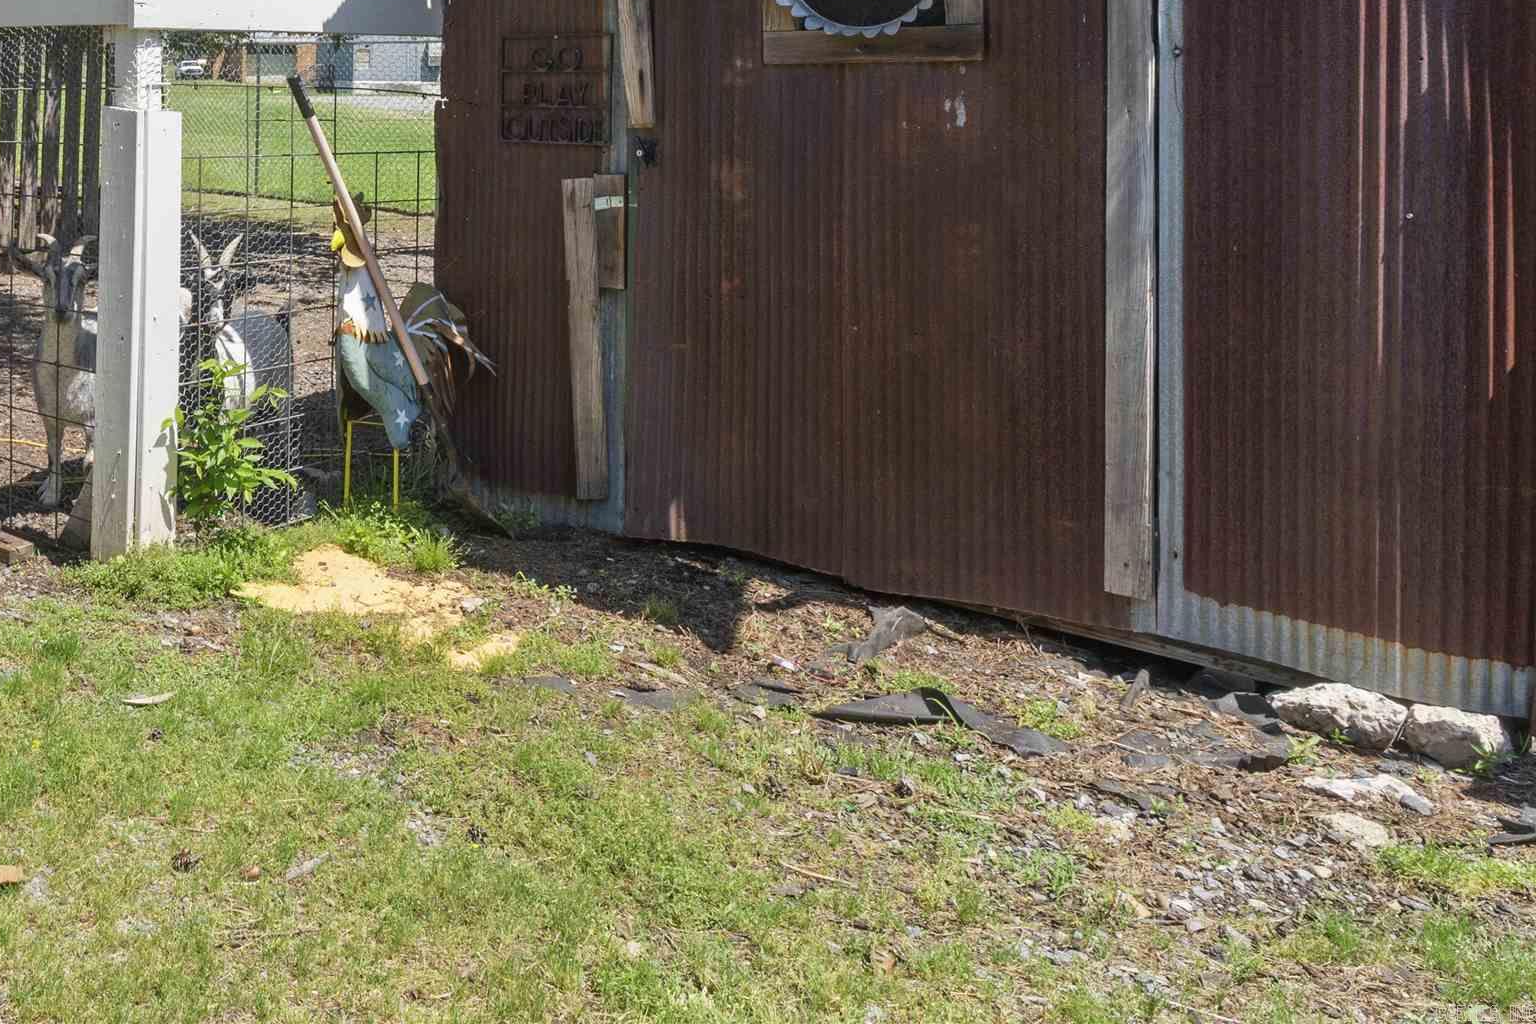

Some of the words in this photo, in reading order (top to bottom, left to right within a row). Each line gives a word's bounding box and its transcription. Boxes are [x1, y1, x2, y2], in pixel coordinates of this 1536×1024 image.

[531, 47, 584, 71] GO
[523, 80, 591, 106] PLAY
[504, 115, 606, 144] OUTSIDE
